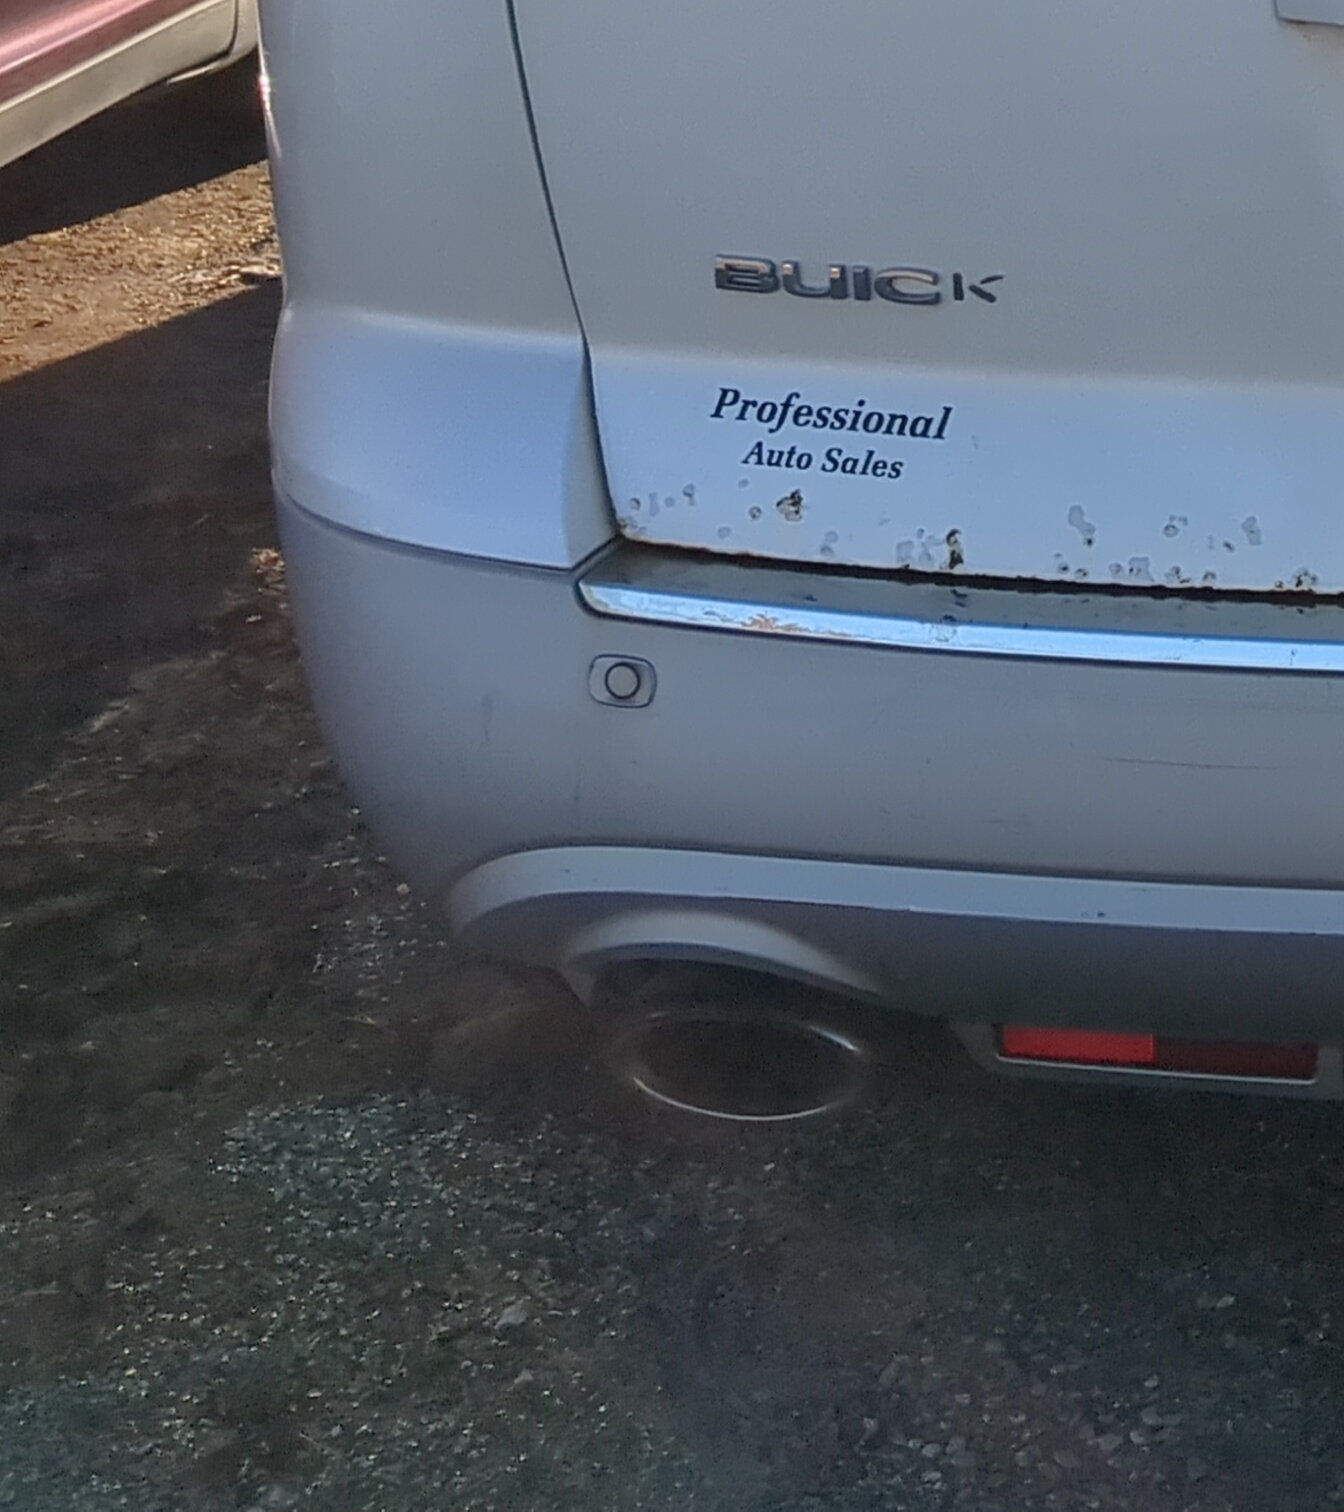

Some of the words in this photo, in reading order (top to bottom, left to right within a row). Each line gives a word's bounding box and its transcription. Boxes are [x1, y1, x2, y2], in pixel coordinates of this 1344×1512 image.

[714, 254, 1005, 306] BUICK
[710, 387, 953, 440] Professional
[741, 441, 813, 470] Auto
[821, 447, 904, 479] Sales
